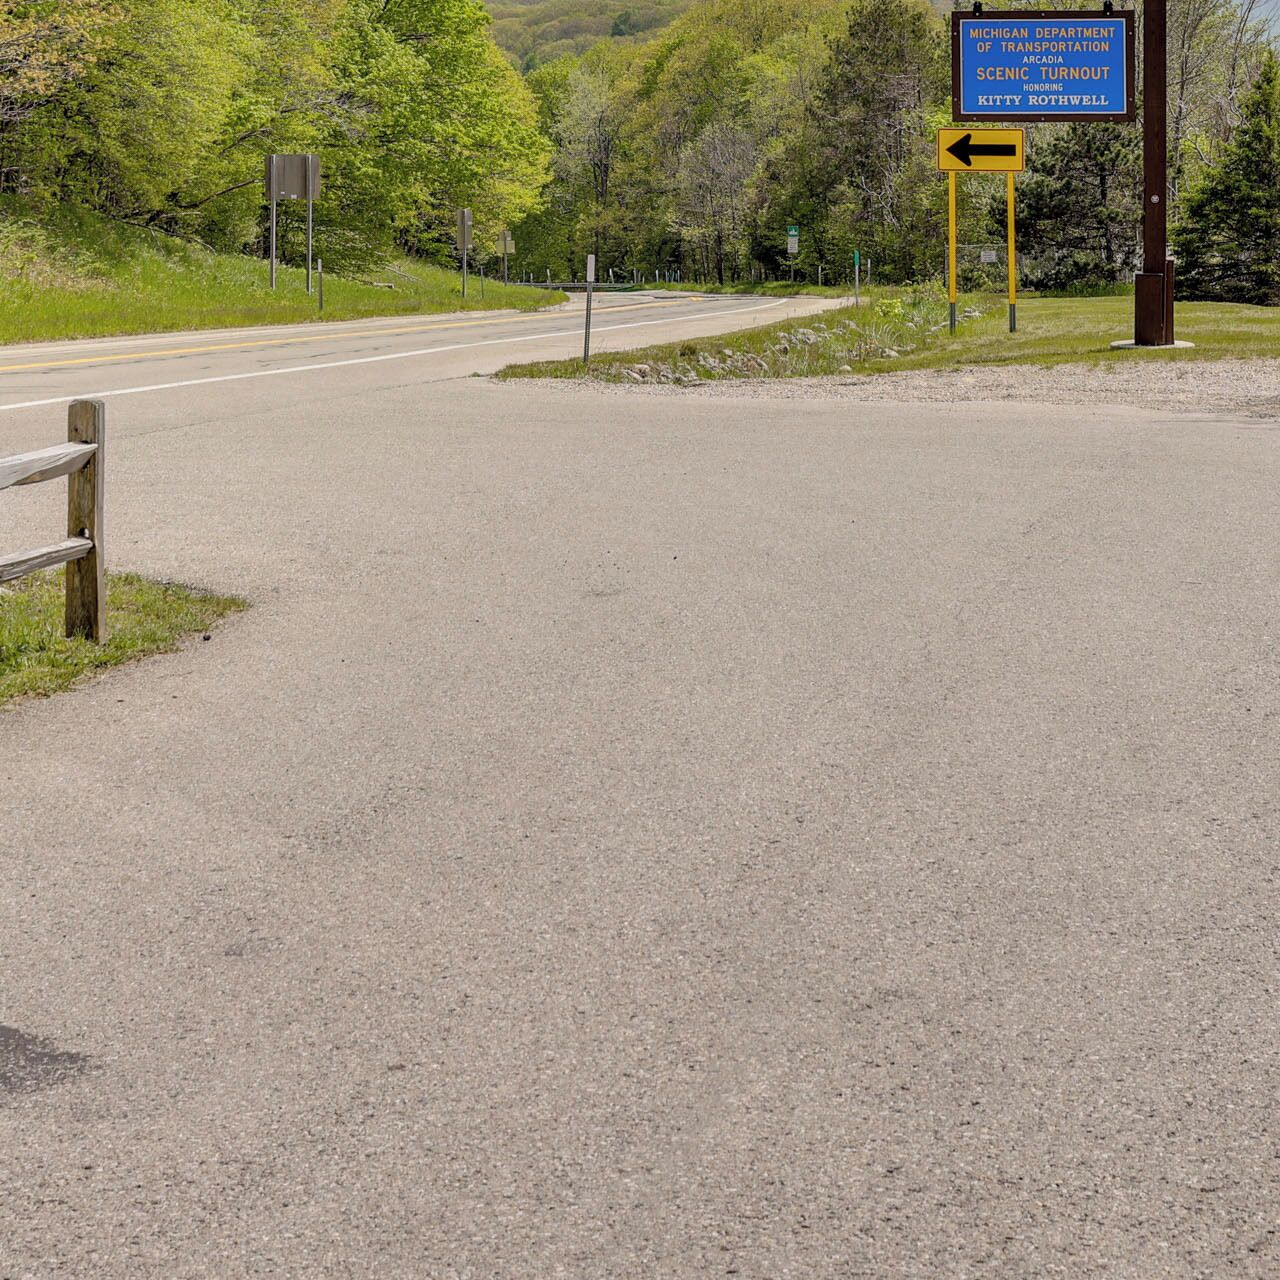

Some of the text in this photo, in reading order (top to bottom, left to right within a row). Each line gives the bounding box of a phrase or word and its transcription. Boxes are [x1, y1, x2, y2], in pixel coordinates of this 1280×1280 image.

[970, 27, 1115, 38] MICHIGAN DEPARTMENT
[977, 41, 1109, 53] OF TRANSPORTATION
[1023, 55, 1063, 64] ARCADIA
[976, 67, 1109, 80] SCENIC TURNOUT
[1023, 83, 1063, 92] HONORING
[978, 95, 1109, 105] KITTY ROTHWELL
